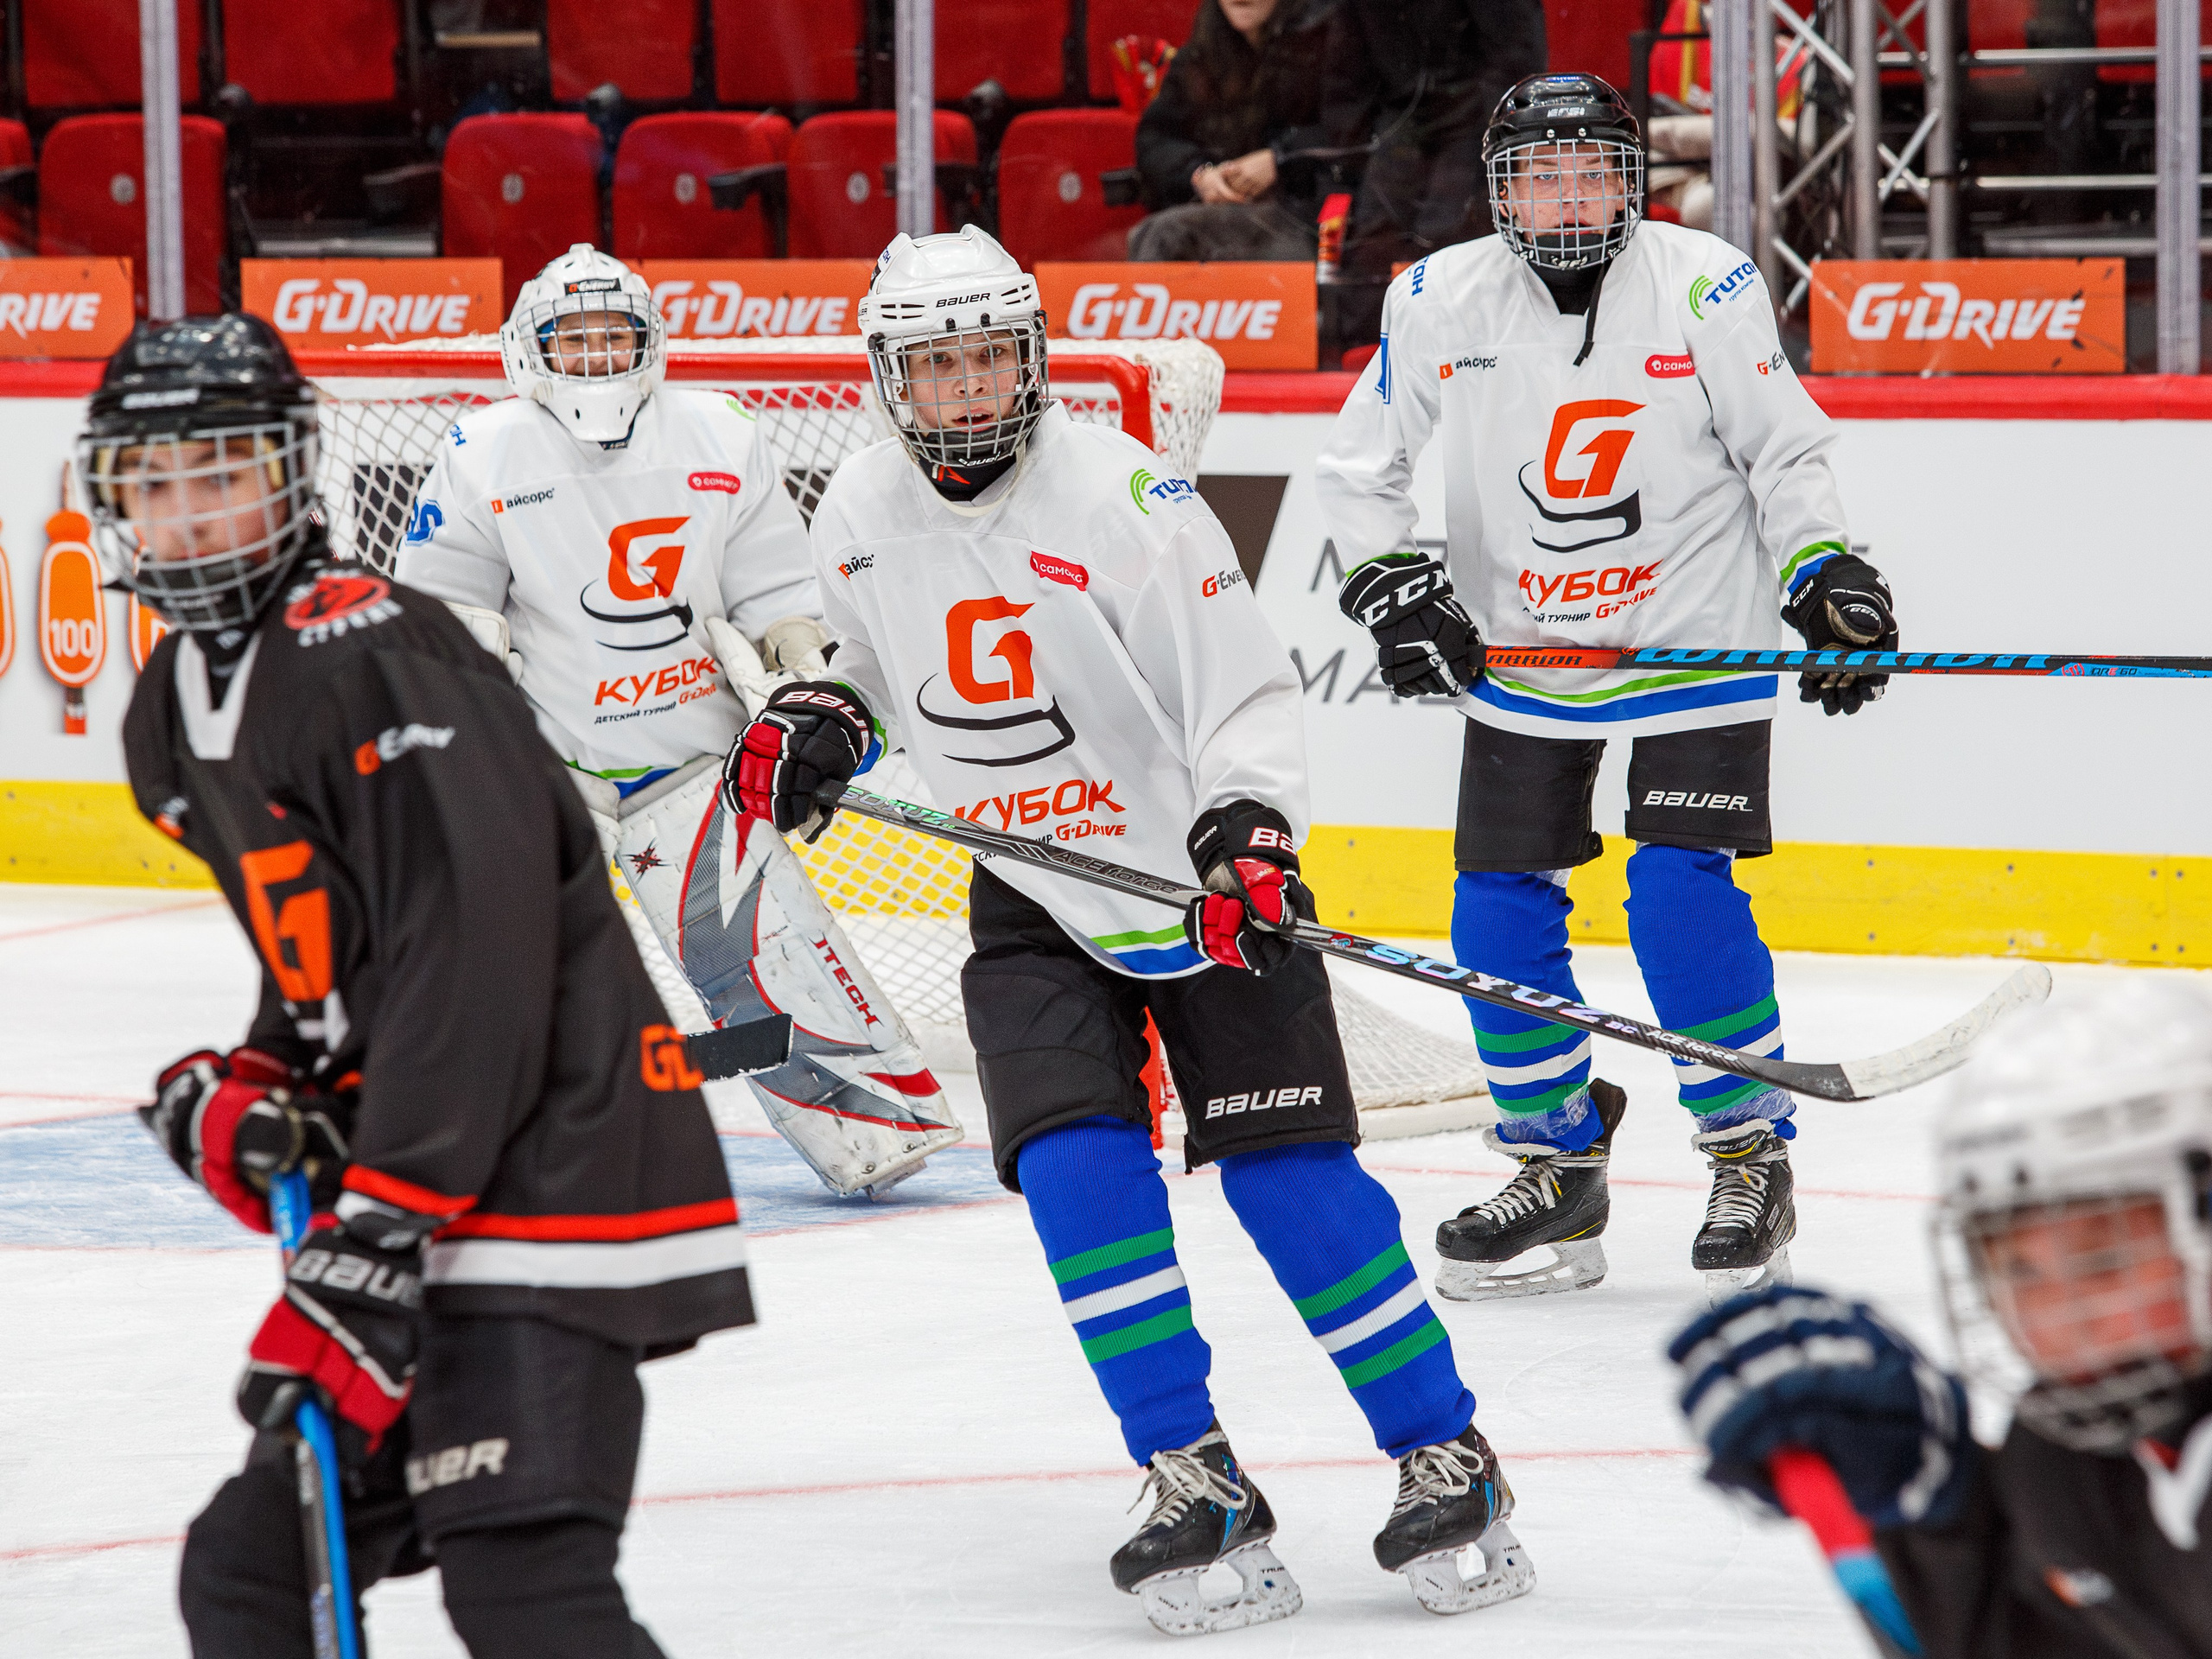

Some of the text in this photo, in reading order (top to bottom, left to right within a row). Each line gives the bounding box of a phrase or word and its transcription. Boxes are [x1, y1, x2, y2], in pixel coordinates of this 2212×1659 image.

[0, 292, 102, 340] RIVE
[936, 292, 991, 308] BAUER
[1662, 359, 1694, 371] само
[506, 487, 556, 509] айсорс
[1518, 558, 1664, 608] КУБОК
[1548, 612, 1591, 624] ТУРНИР
[49, 618, 96, 658] 100
[1487, 654, 1583, 667] ARRIOR
[594, 657, 719, 707] КУБОК
[594, 709, 640, 724] ДЕТСКИЙ
[776, 690, 870, 757] BAU
[841, 786, 950, 825] SOYUZ
[955, 779, 1127, 832] КУБОК
[1643, 790, 1752, 812] BAUER
[1051, 851, 1109, 873] ACE
[1363, 944, 1611, 1024] SOYUZ
[1646, 1029, 1687, 1046] ACE
[1205, 1086, 1323, 1120] BAUER
[404, 1437, 510, 1497] UER
